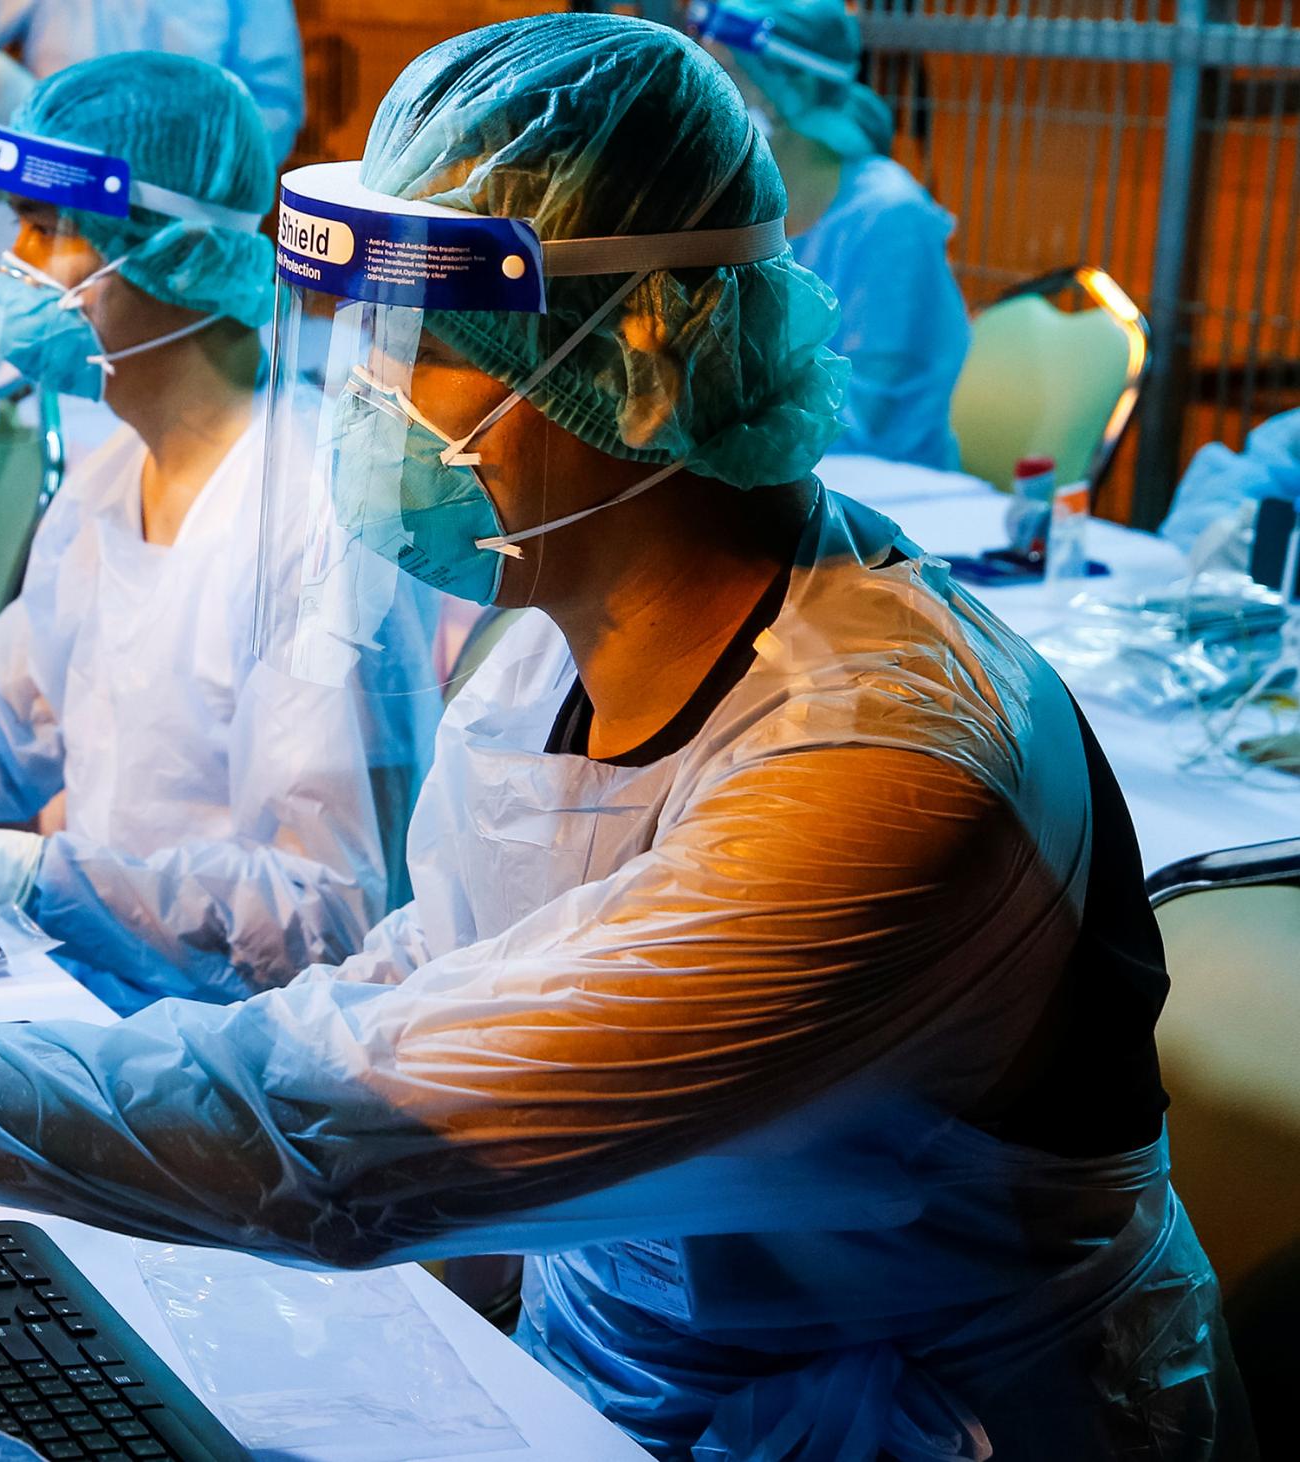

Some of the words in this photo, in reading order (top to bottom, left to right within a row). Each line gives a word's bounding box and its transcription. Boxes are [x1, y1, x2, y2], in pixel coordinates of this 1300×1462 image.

[281, 212, 330, 256] Shield
[369, 239, 394, 249] Anti-Fog
[283, 253, 321, 281] Protection
[367, 265, 383, 273] Light
